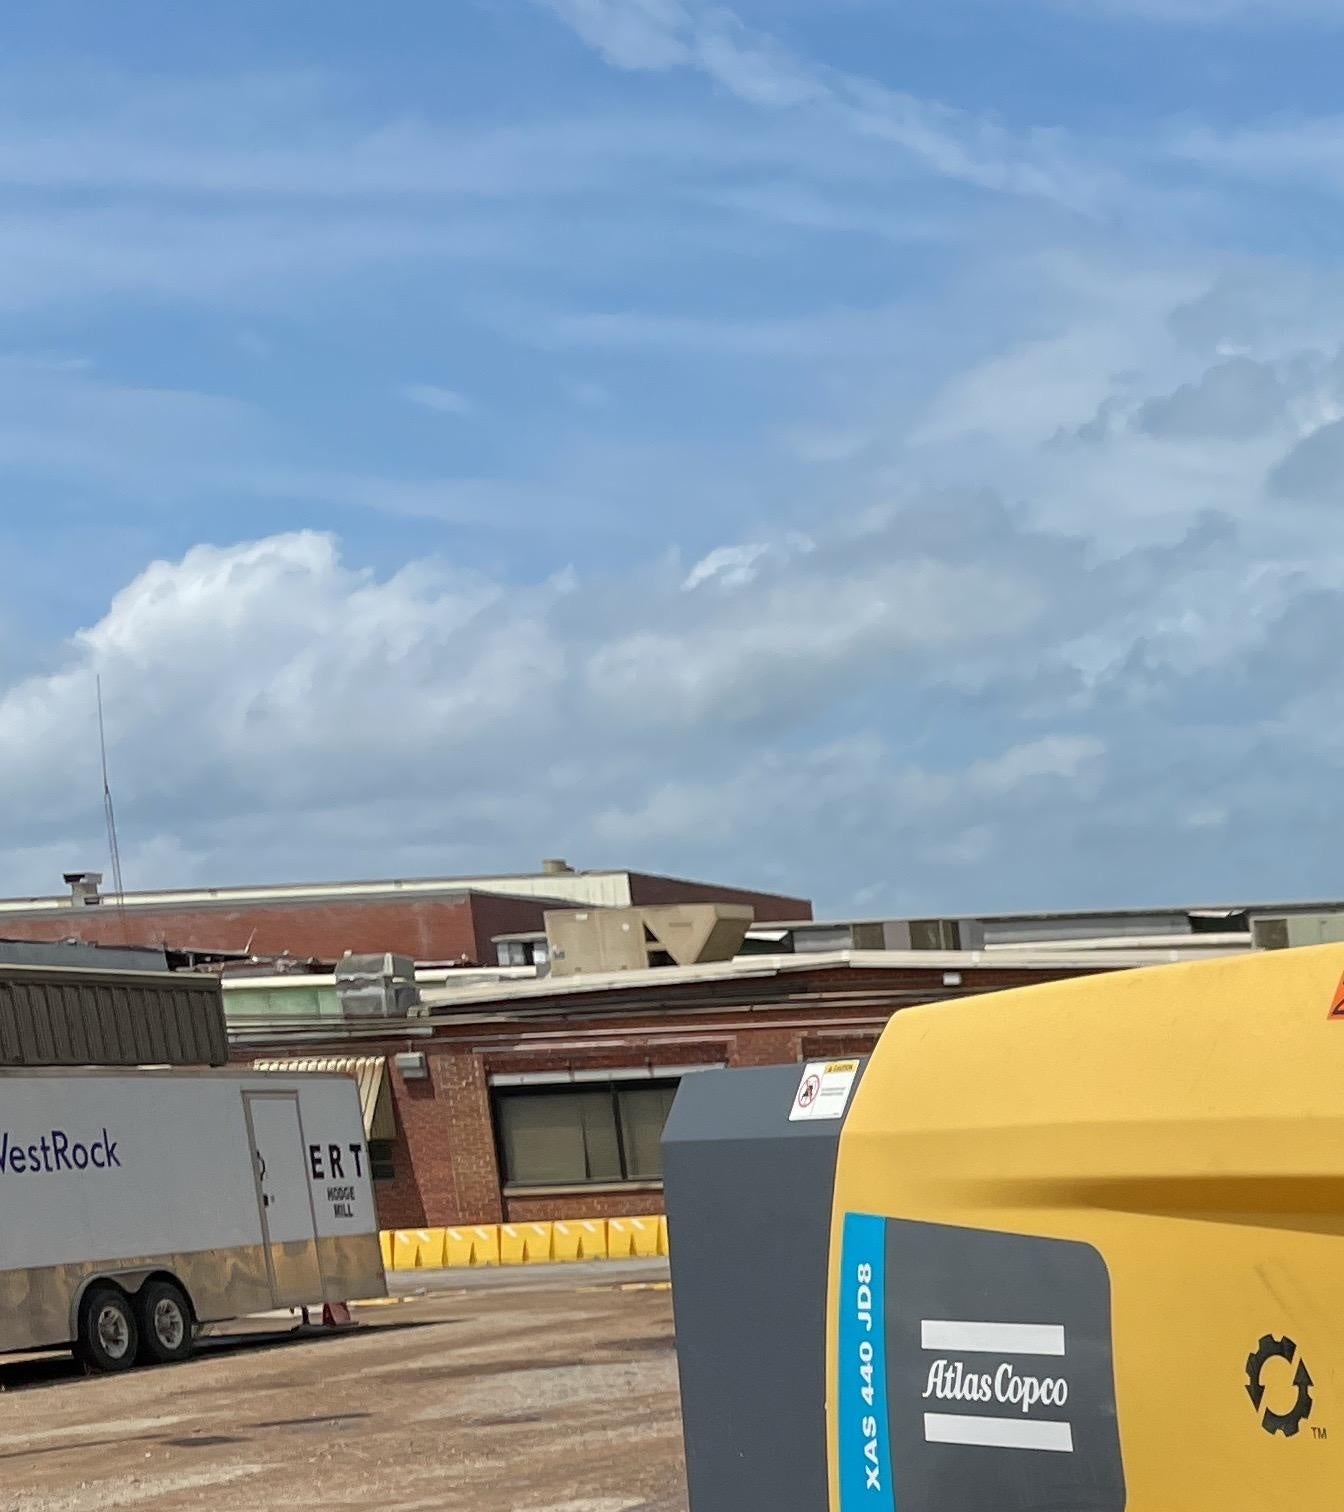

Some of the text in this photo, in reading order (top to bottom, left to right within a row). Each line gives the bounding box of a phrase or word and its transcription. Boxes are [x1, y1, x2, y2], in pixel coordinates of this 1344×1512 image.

[857, 1262, 882, 1492] XAS 440 JD8
